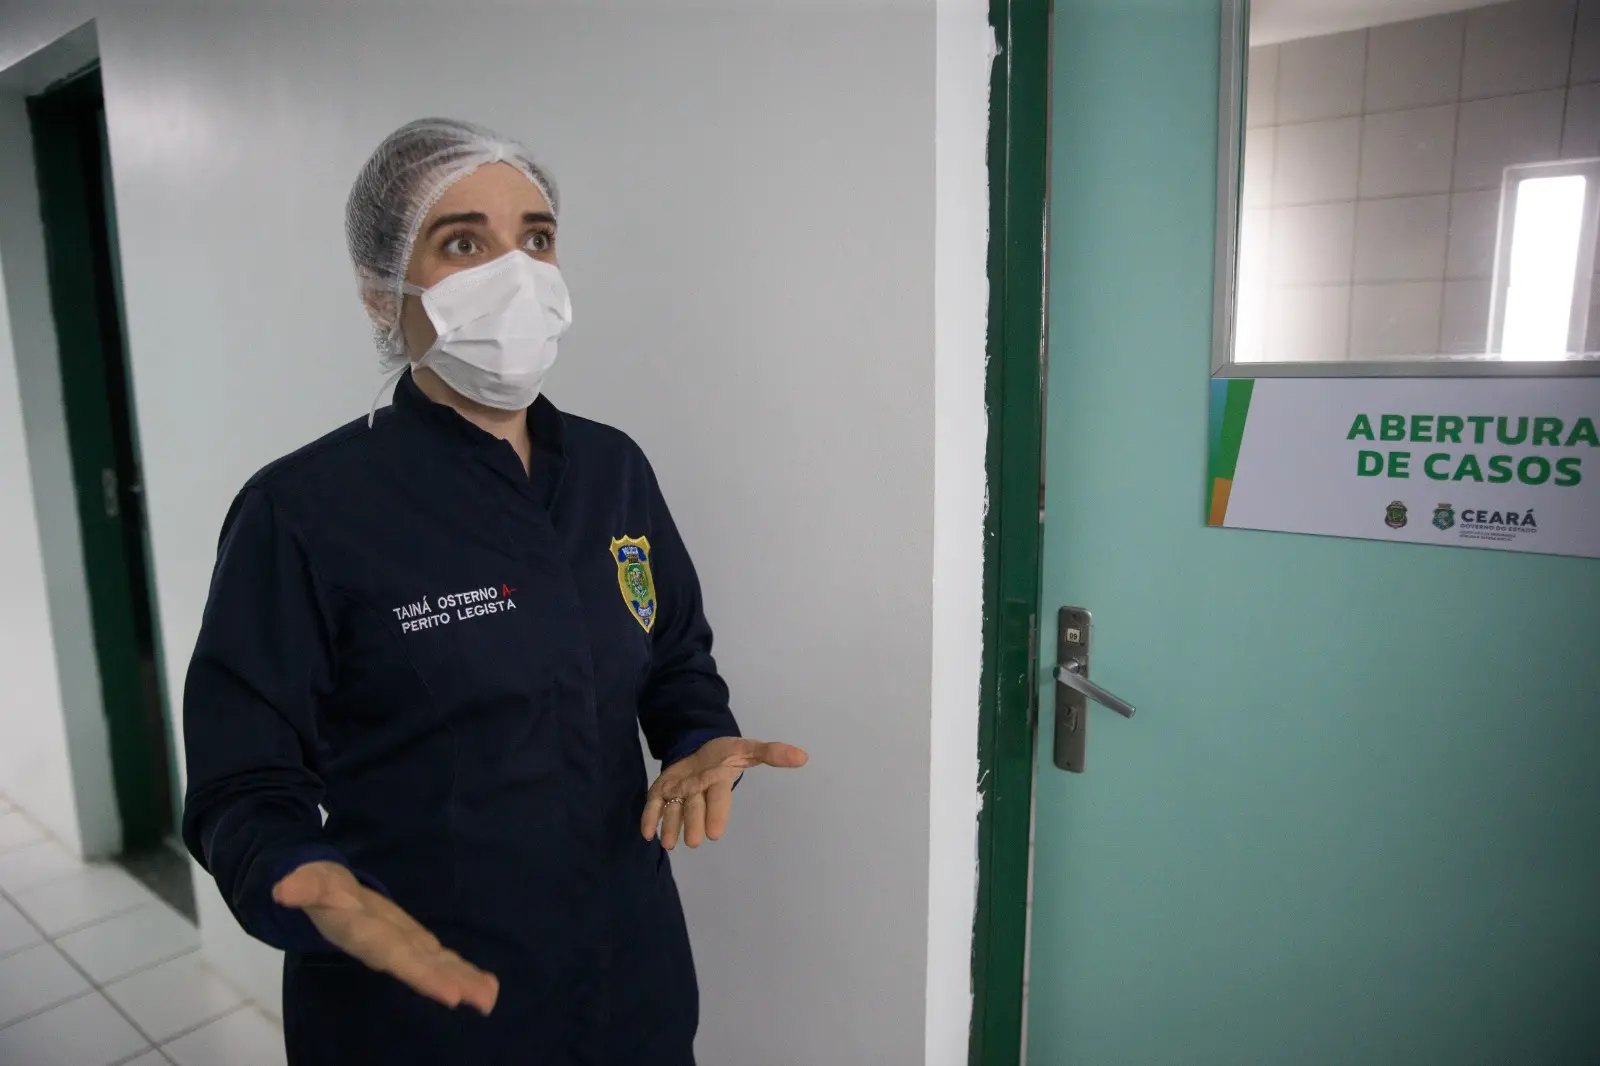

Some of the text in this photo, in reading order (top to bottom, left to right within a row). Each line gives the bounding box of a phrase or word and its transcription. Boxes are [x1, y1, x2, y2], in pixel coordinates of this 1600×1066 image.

[1346, 413, 1600, 448] ABERTURA
[1357, 450, 1582, 487] DE CASOS
[1461, 508, 1537, 527] CEARÁ
[393, 595, 432, 620] TAINÁ
[438, 587, 498, 609] OSTERNO
[402, 598, 517, 634] PERITO LEGISTA
